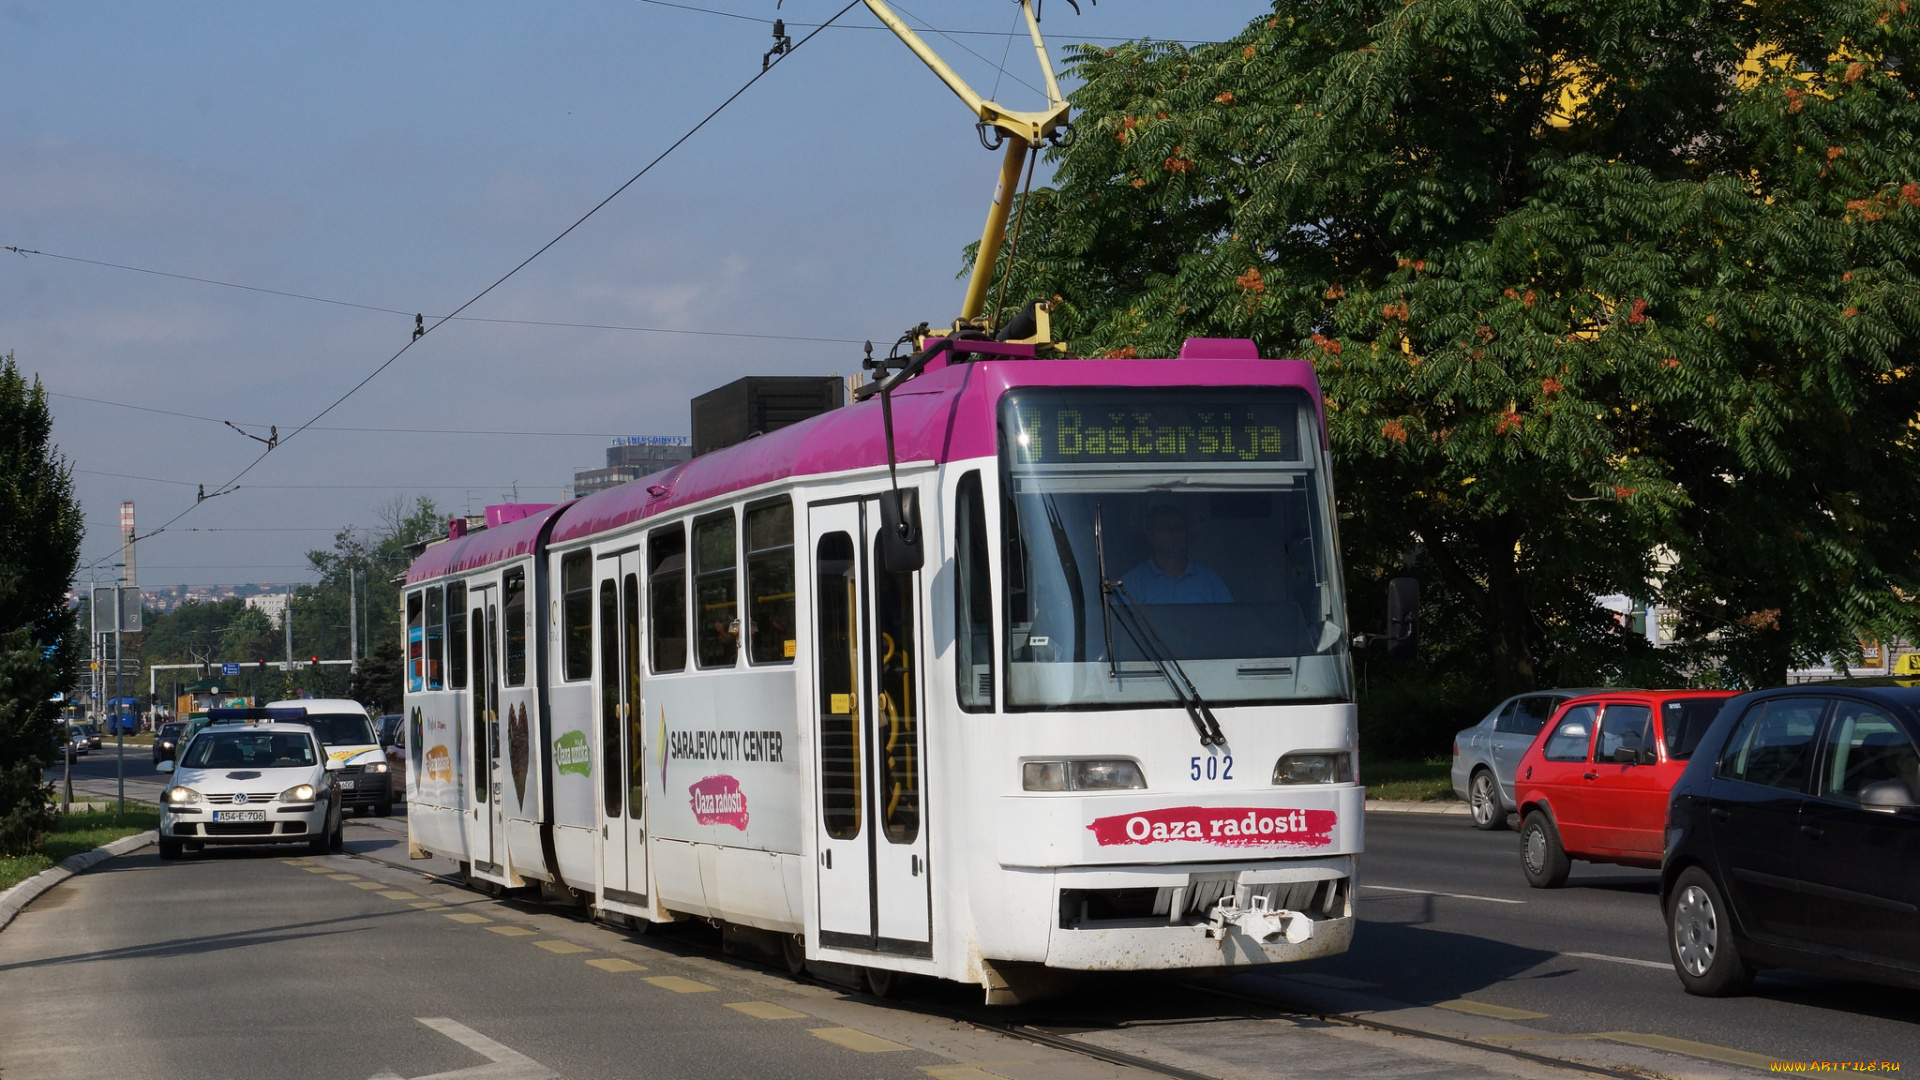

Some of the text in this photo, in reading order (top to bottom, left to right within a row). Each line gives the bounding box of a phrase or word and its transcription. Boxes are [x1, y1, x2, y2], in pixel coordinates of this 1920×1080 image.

[1057, 410, 1282, 460] Baščaršija
[671, 730, 784, 762] SARAJEVO CITY CENTER
[1190, 755, 1234, 781] 502
[694, 785, 743, 815] Oaza radosti
[220, 812, 264, 821] A54-E-706
[1125, 808, 1308, 840] Oaza radosti
